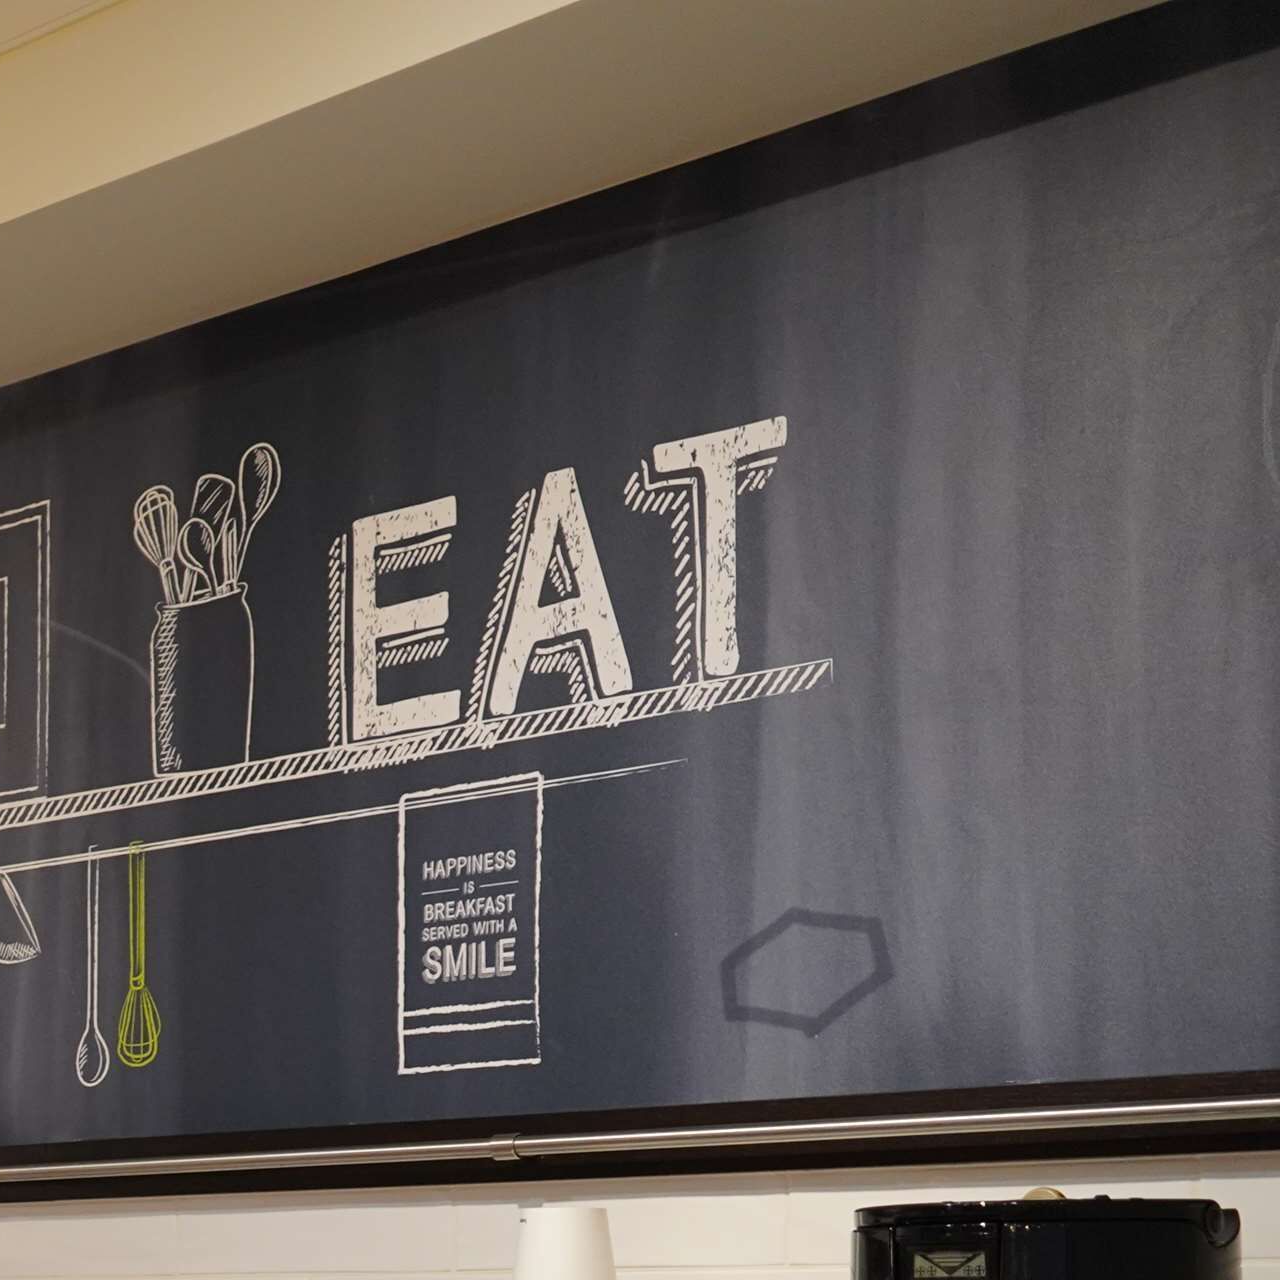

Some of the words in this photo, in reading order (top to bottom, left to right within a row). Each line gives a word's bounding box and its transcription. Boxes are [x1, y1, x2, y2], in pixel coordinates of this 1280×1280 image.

[330, 415, 788, 745] EAT
[422, 850, 516, 881] HAPPINESS
[463, 881, 475, 895] IS
[423, 894, 516, 923] BREAKFAST
[421, 923, 468, 942] SERVED
[473, 920, 504, 936] WITH
[508, 918, 518, 932] A
[421, 937, 516, 984] SMILE
